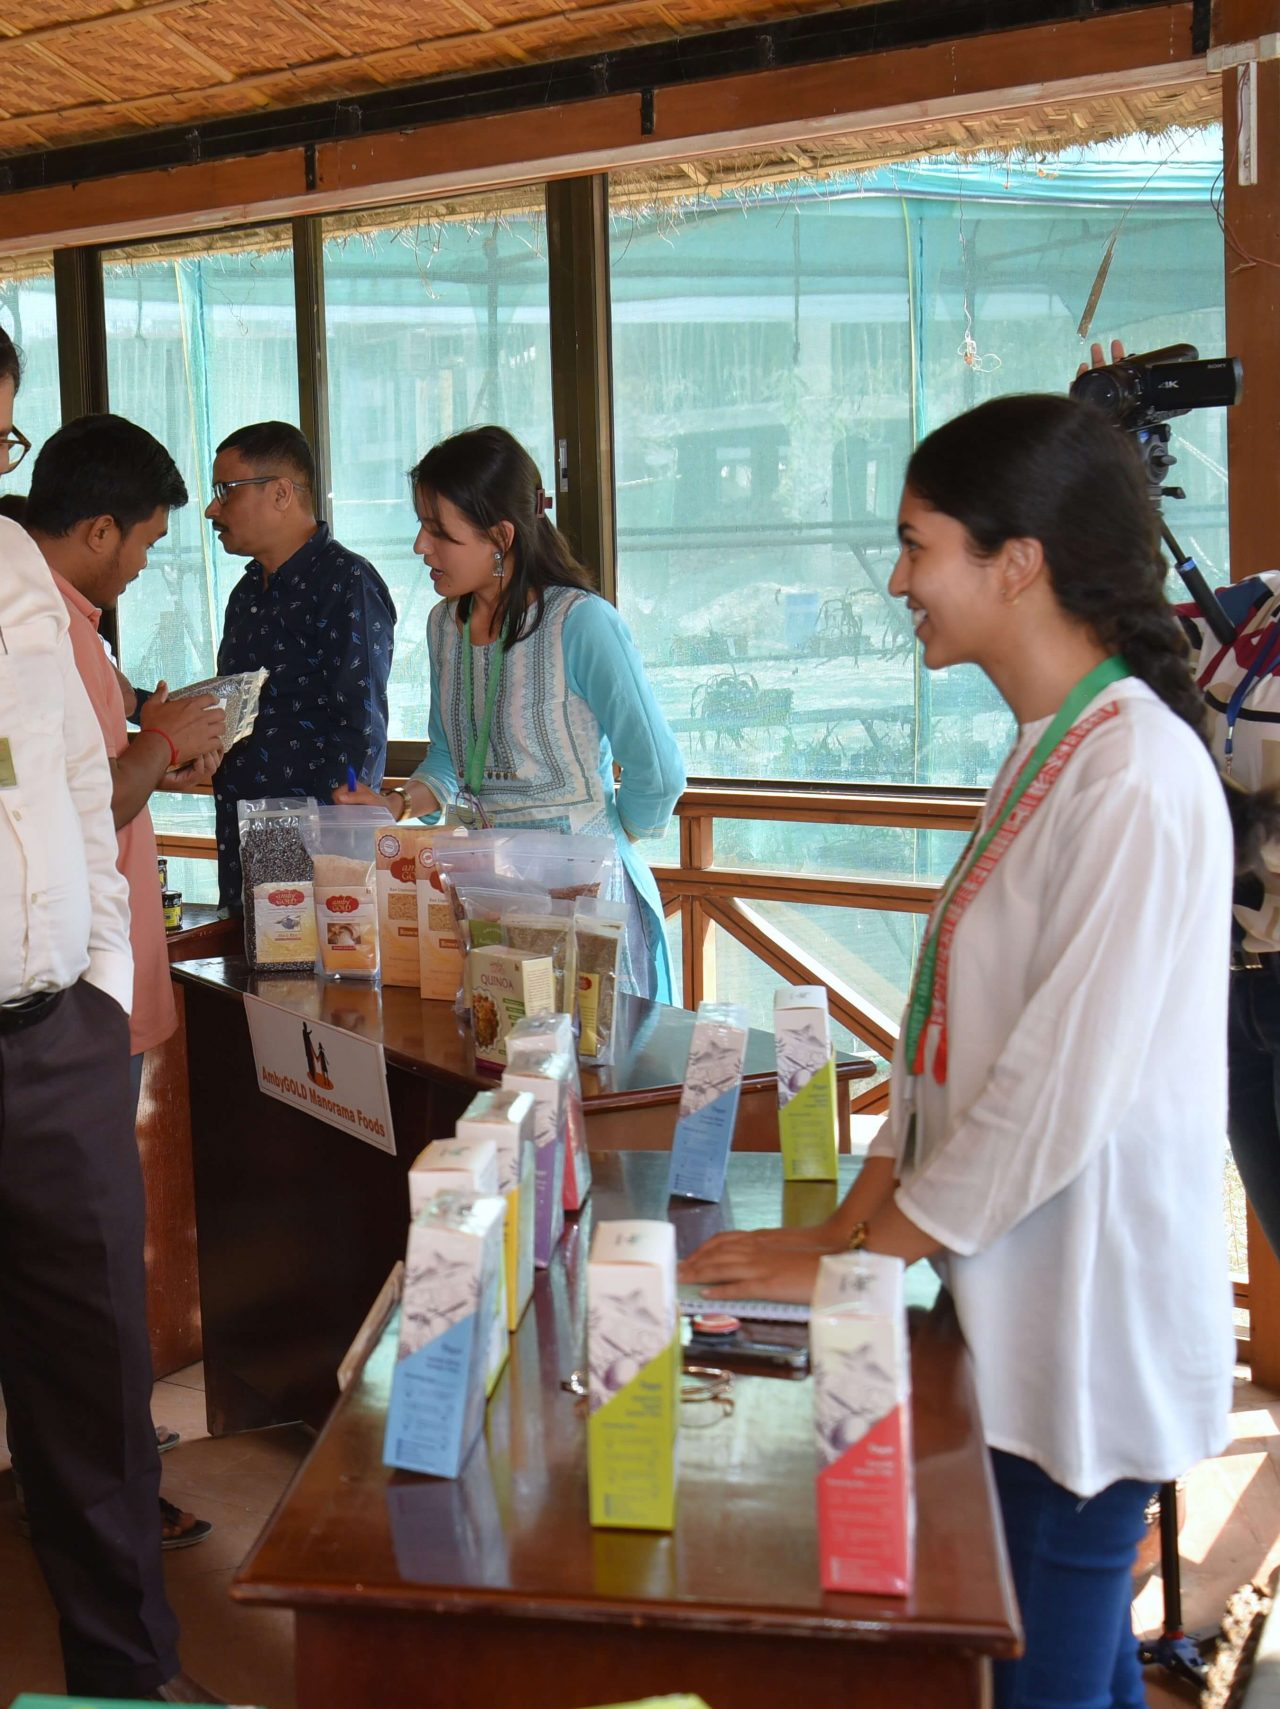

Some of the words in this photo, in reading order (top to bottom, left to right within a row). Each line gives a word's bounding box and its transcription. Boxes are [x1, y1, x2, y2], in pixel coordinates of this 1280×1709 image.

[1158, 380, 1180, 388] 4K
[481, 974, 513, 990] QUINOA
[262, 1066, 307, 1100] AmbyGOLD
[310, 1088, 355, 1123] Manorama
[357, 1110, 385, 1137] Foods
